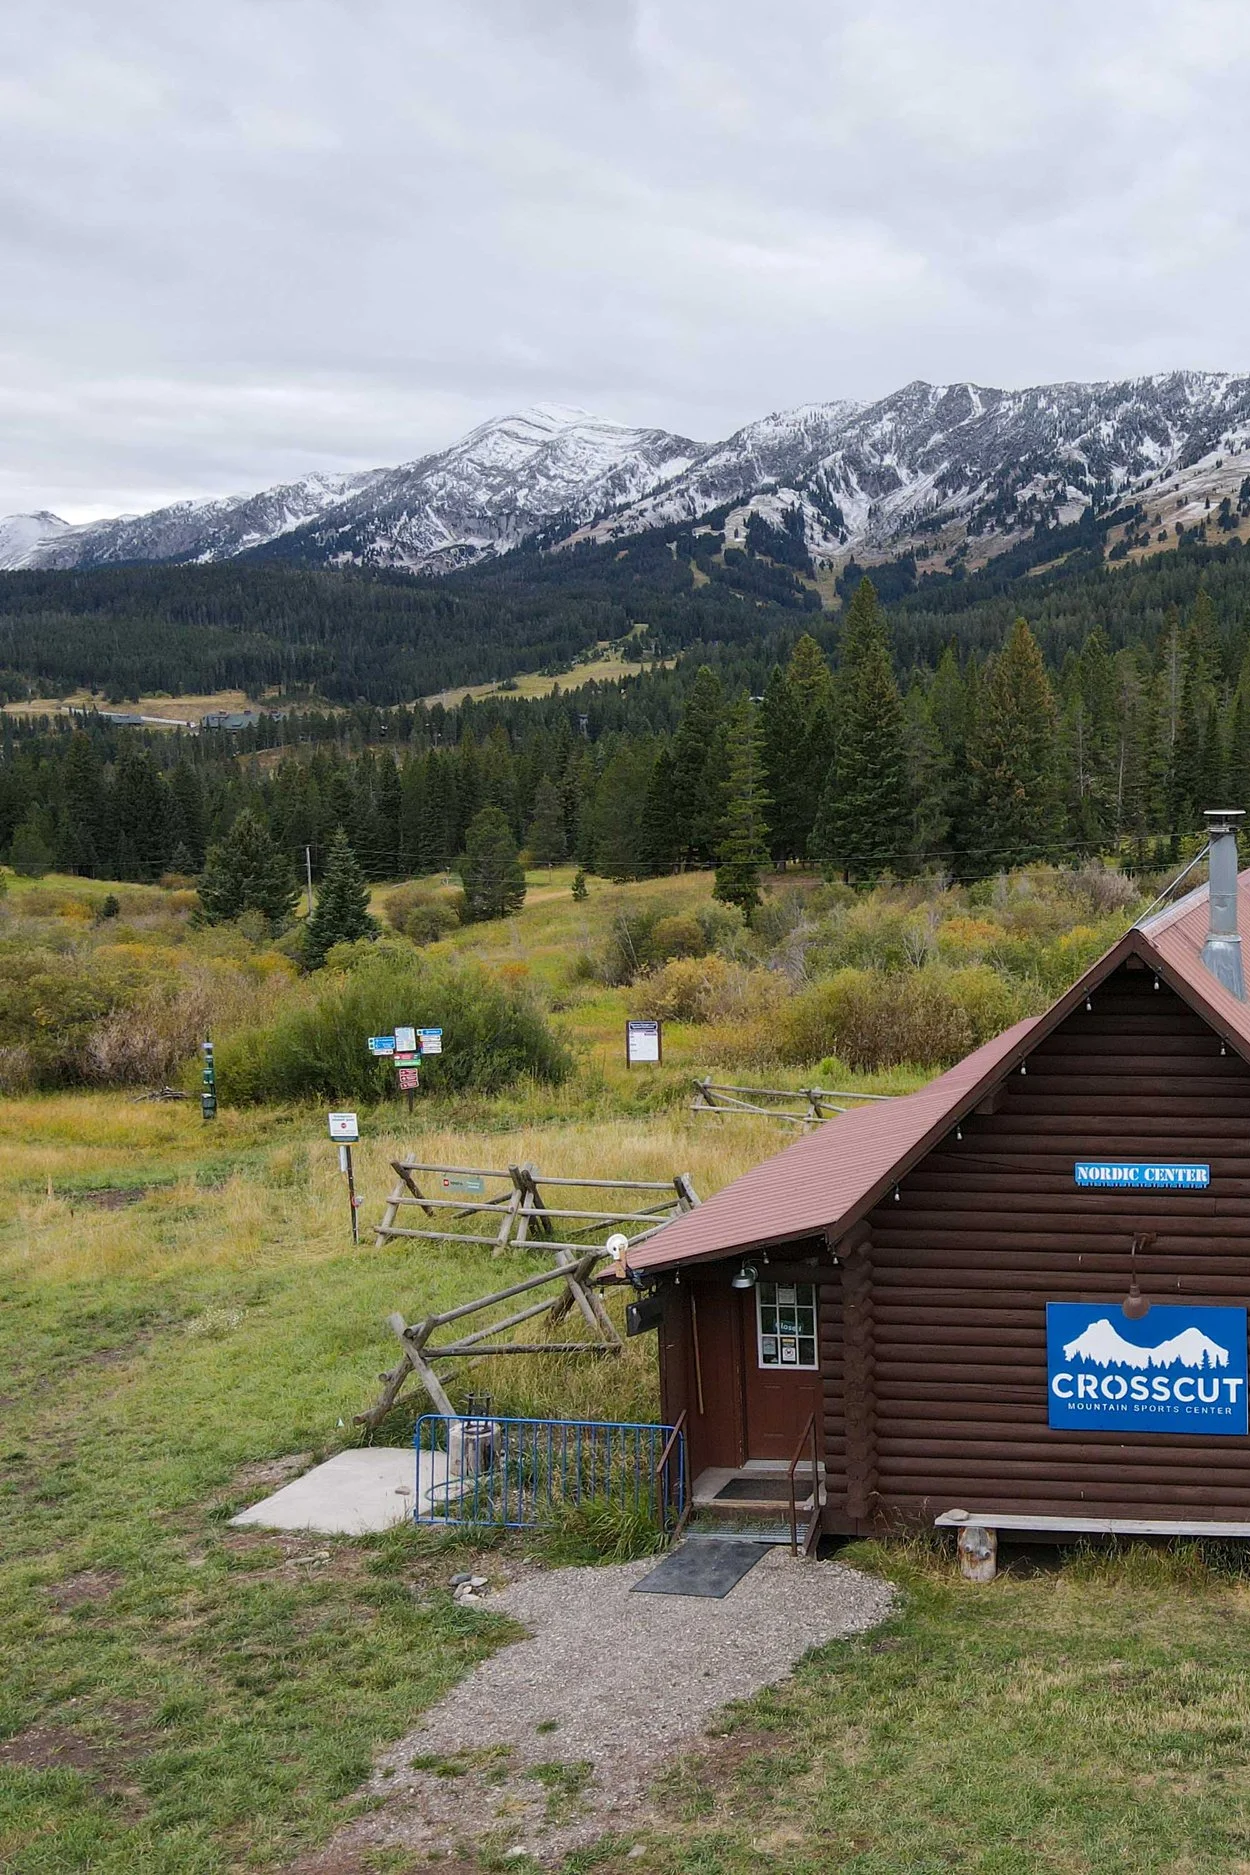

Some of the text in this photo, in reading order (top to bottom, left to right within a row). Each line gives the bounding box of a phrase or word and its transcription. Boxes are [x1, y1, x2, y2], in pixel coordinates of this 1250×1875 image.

[1077, 1166, 1208, 1182] NORDIC CENTER
[1051, 1372, 1244, 1403] CROSSCUT
[1067, 1402, 1233, 1415] MOUNTAIN SPORTS CENTER
